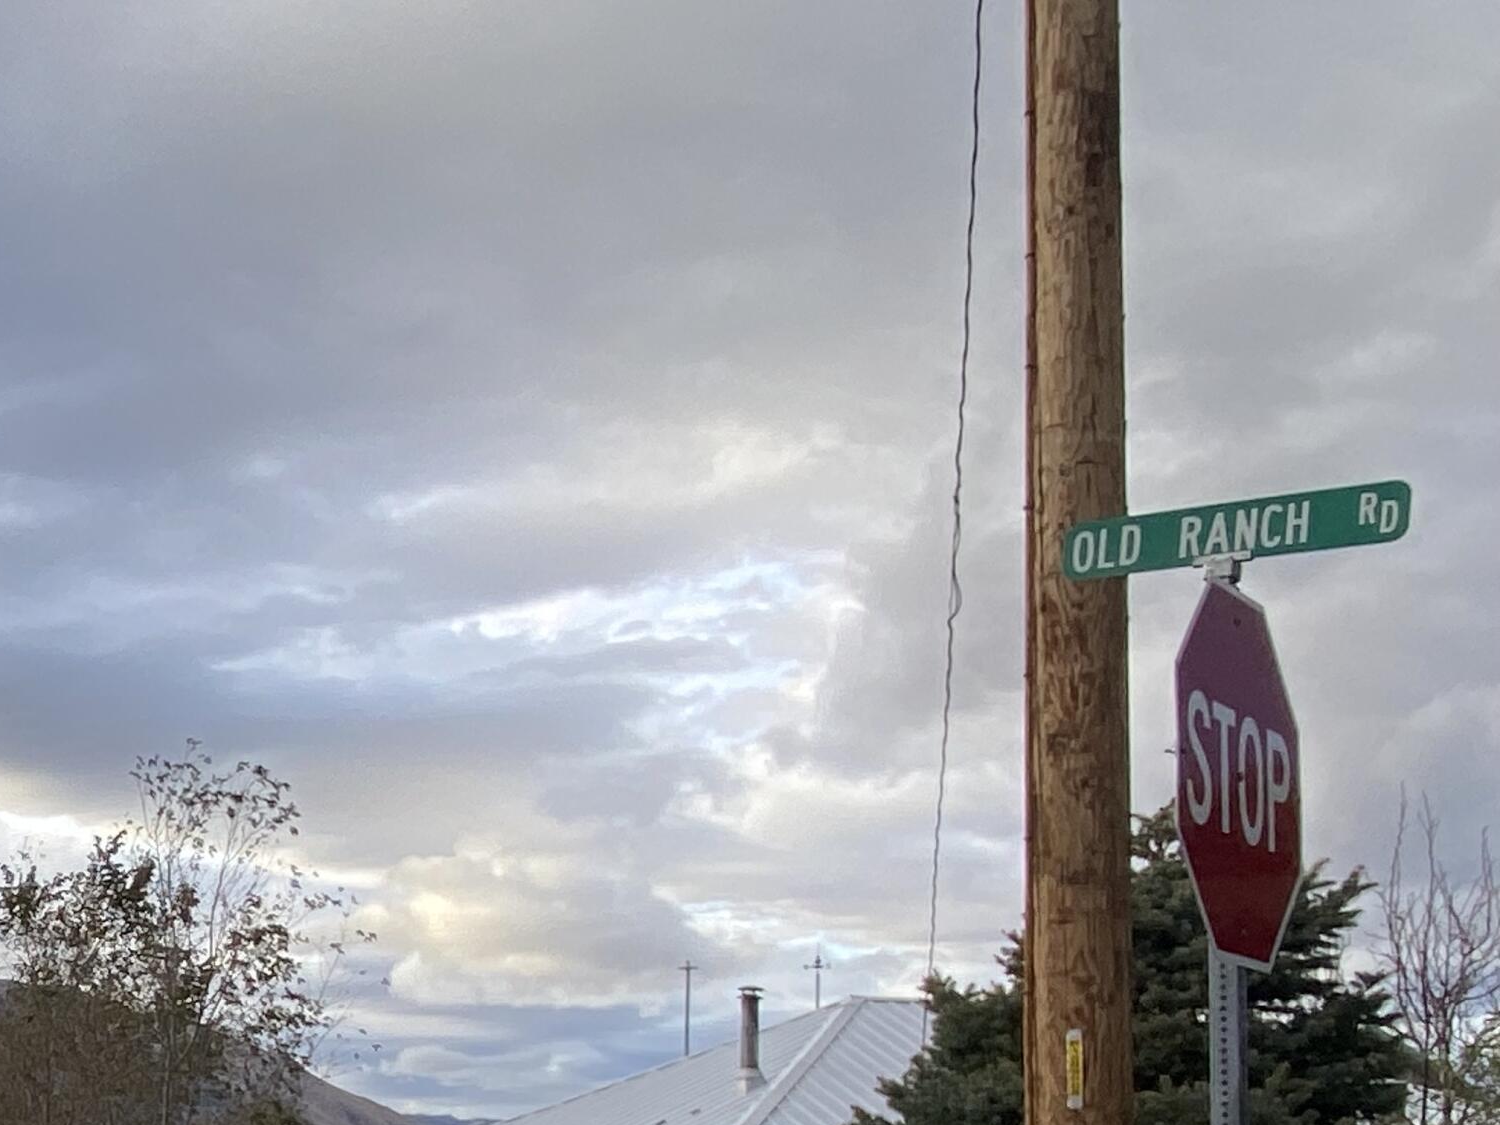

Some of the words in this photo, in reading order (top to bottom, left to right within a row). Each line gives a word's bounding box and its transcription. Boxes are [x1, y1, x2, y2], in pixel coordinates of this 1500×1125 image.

[1072, 524, 1142, 574] OLD
[1178, 500, 1311, 559] RANCH
[1358, 492, 1400, 535] RD
[1186, 689, 1291, 853] STOP
